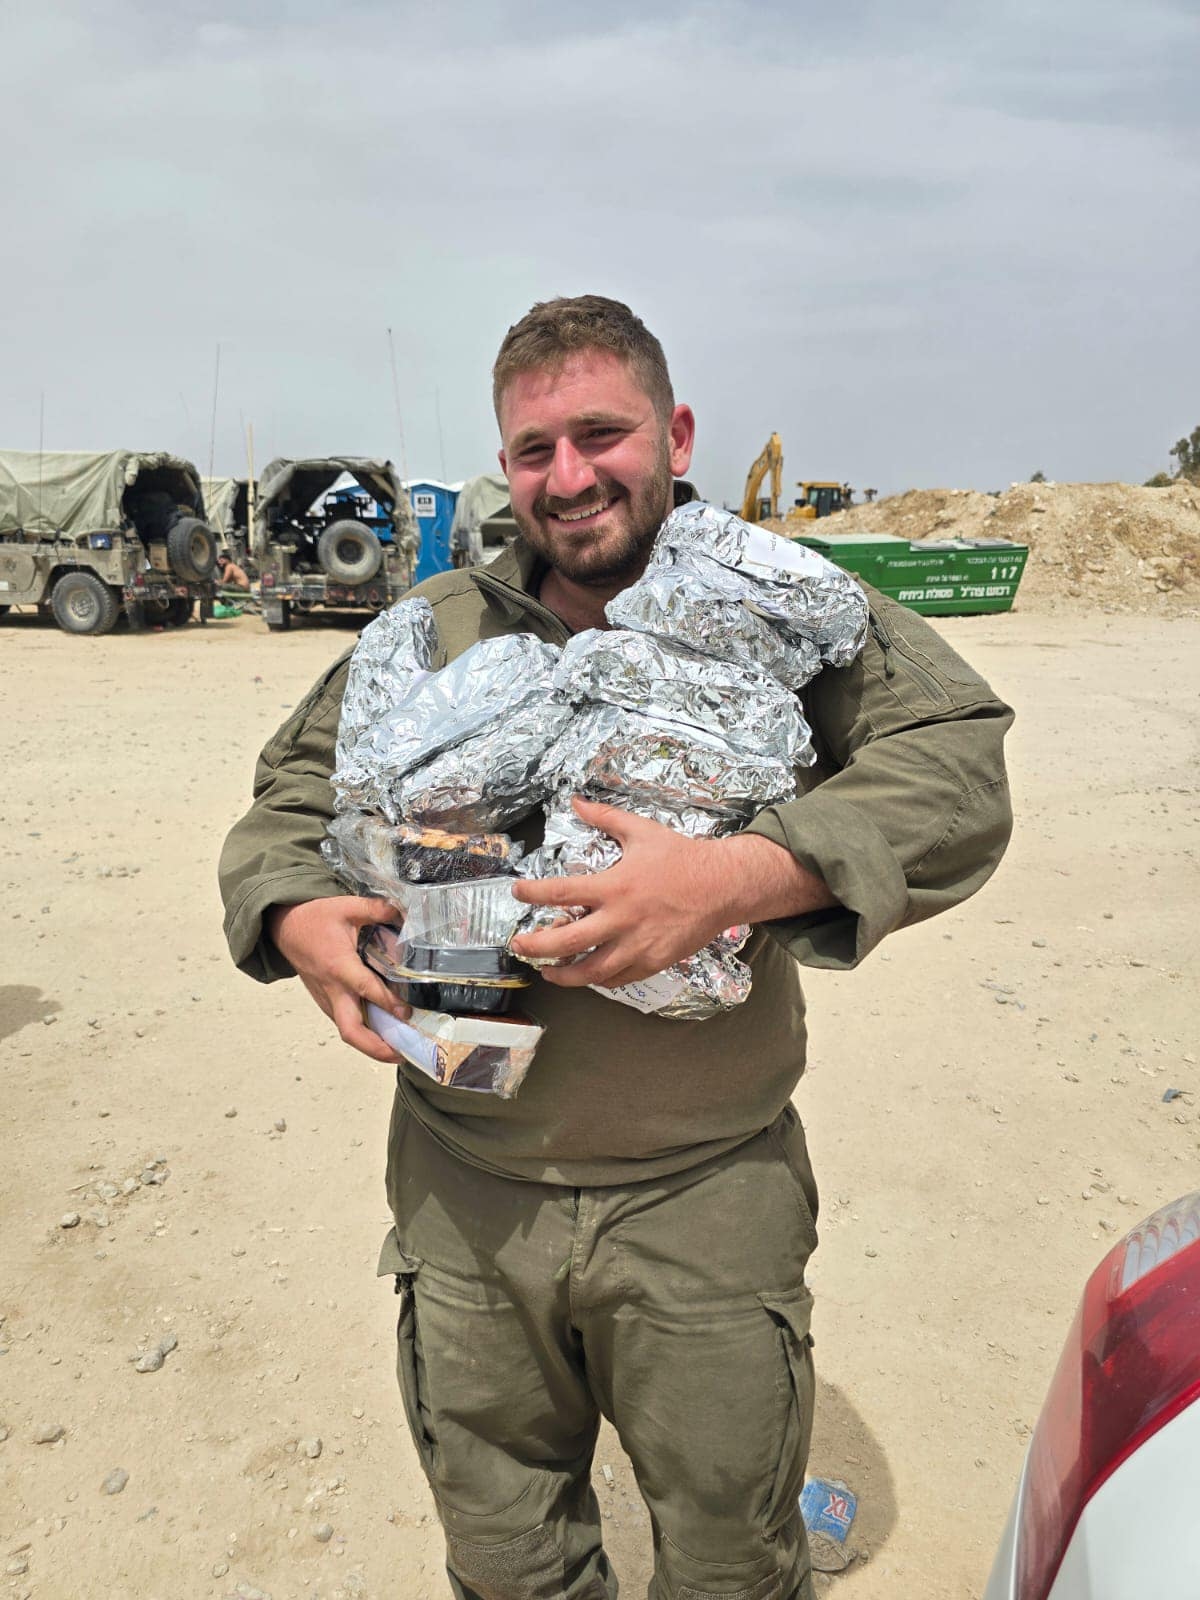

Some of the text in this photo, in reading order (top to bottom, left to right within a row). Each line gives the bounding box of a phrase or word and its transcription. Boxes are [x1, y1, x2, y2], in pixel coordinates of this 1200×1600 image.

[991, 565, 1018, 580] 117
[986, 585, 1010, 597] רכוש
[822, 1492, 851, 1524] XL
